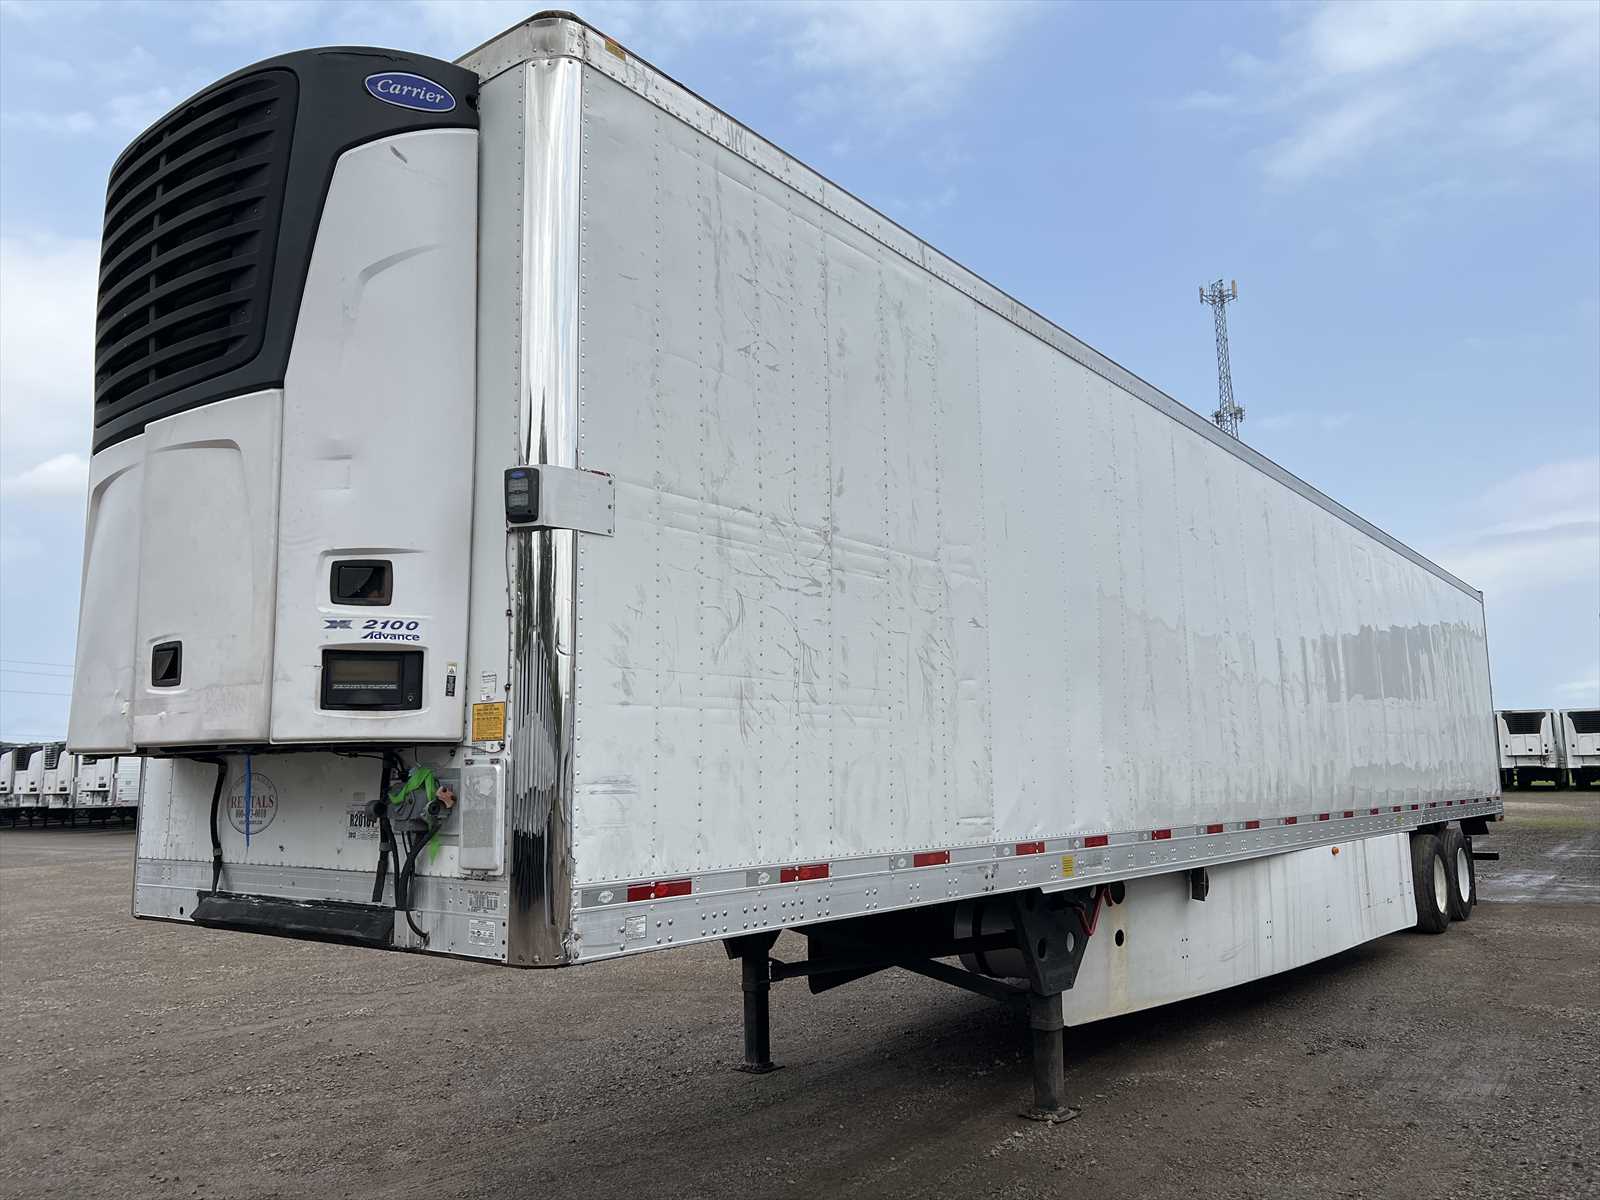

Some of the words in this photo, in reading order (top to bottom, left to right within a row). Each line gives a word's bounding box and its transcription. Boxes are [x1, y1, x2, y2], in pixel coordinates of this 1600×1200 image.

[377, 79, 444, 104] Carrier
[362, 619, 420, 631] 2100
[361, 630, 420, 642] Advance
[231, 795, 274, 809] RETALS
